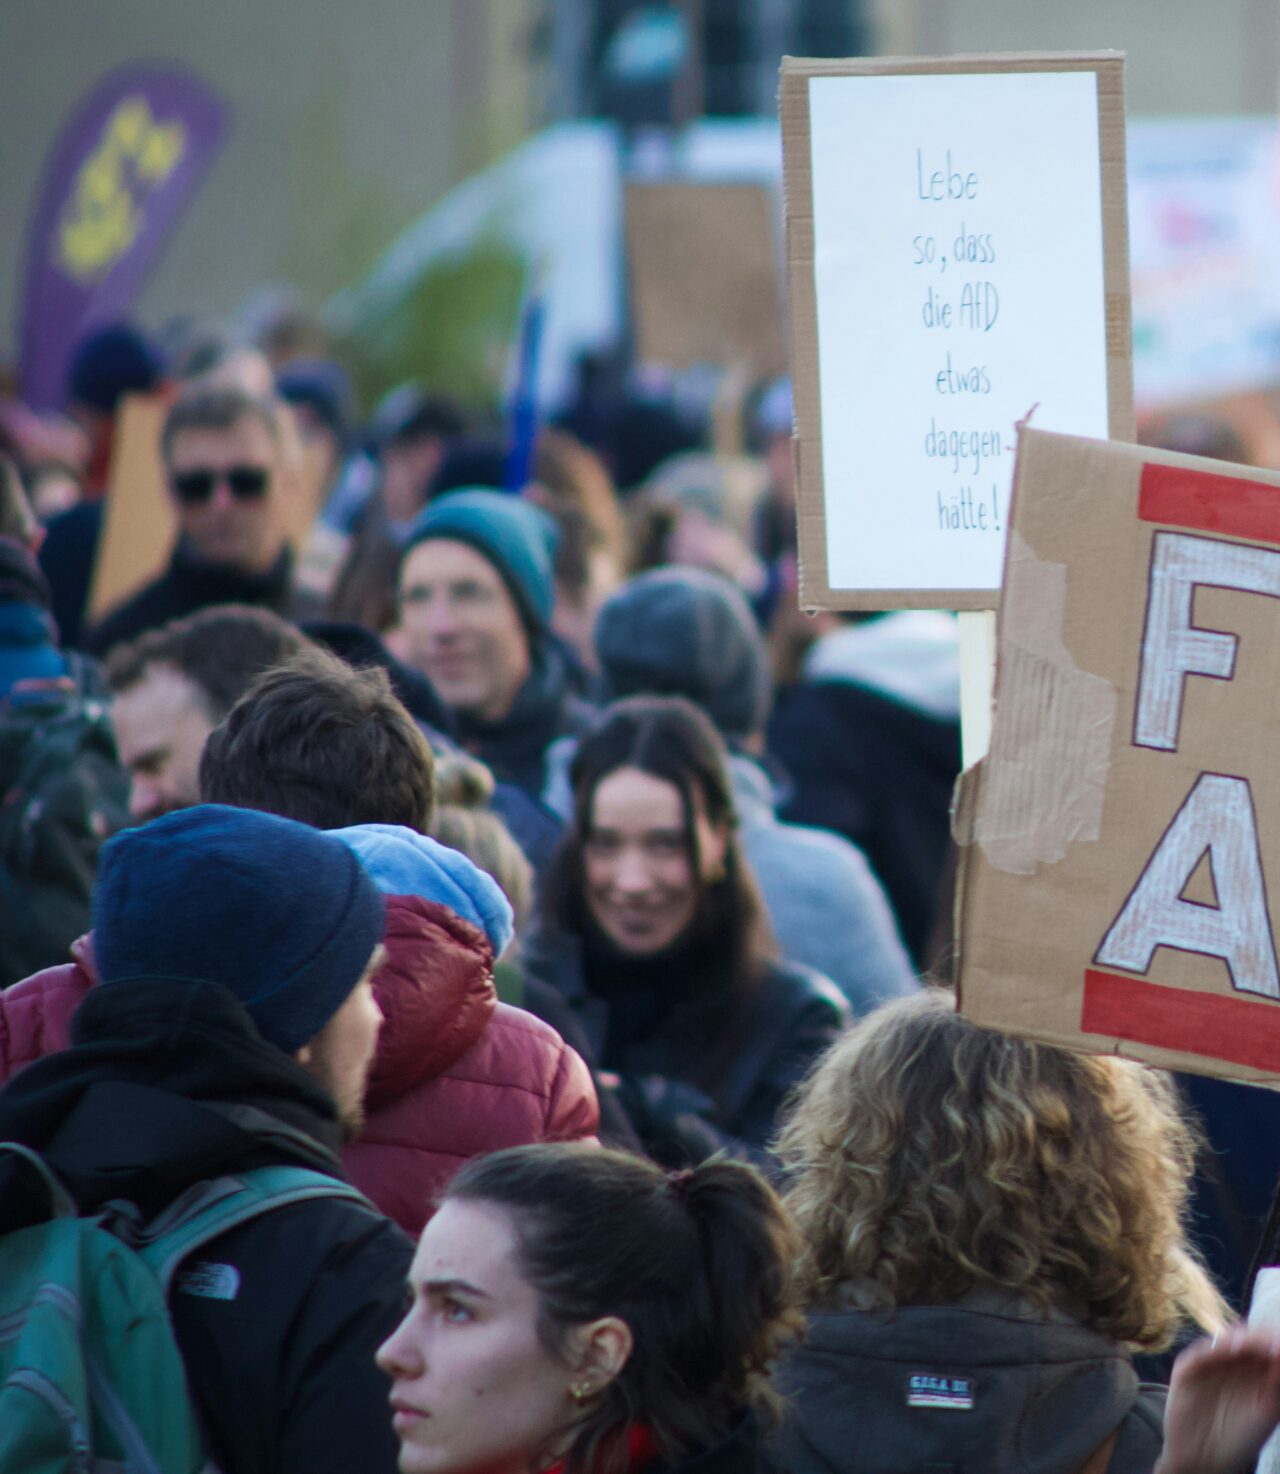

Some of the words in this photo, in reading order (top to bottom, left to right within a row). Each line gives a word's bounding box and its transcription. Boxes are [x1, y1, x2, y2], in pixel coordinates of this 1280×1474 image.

[917, 147, 979, 201] Lebe
[912, 234, 947, 273] so,
[953, 221, 996, 263] dass
[922, 286, 952, 329] die
[960, 281, 999, 332] AfD
[936, 351, 991, 394] etwas
[924, 416, 1001, 475] dagegen
[937, 483, 1001, 531] hätte!
